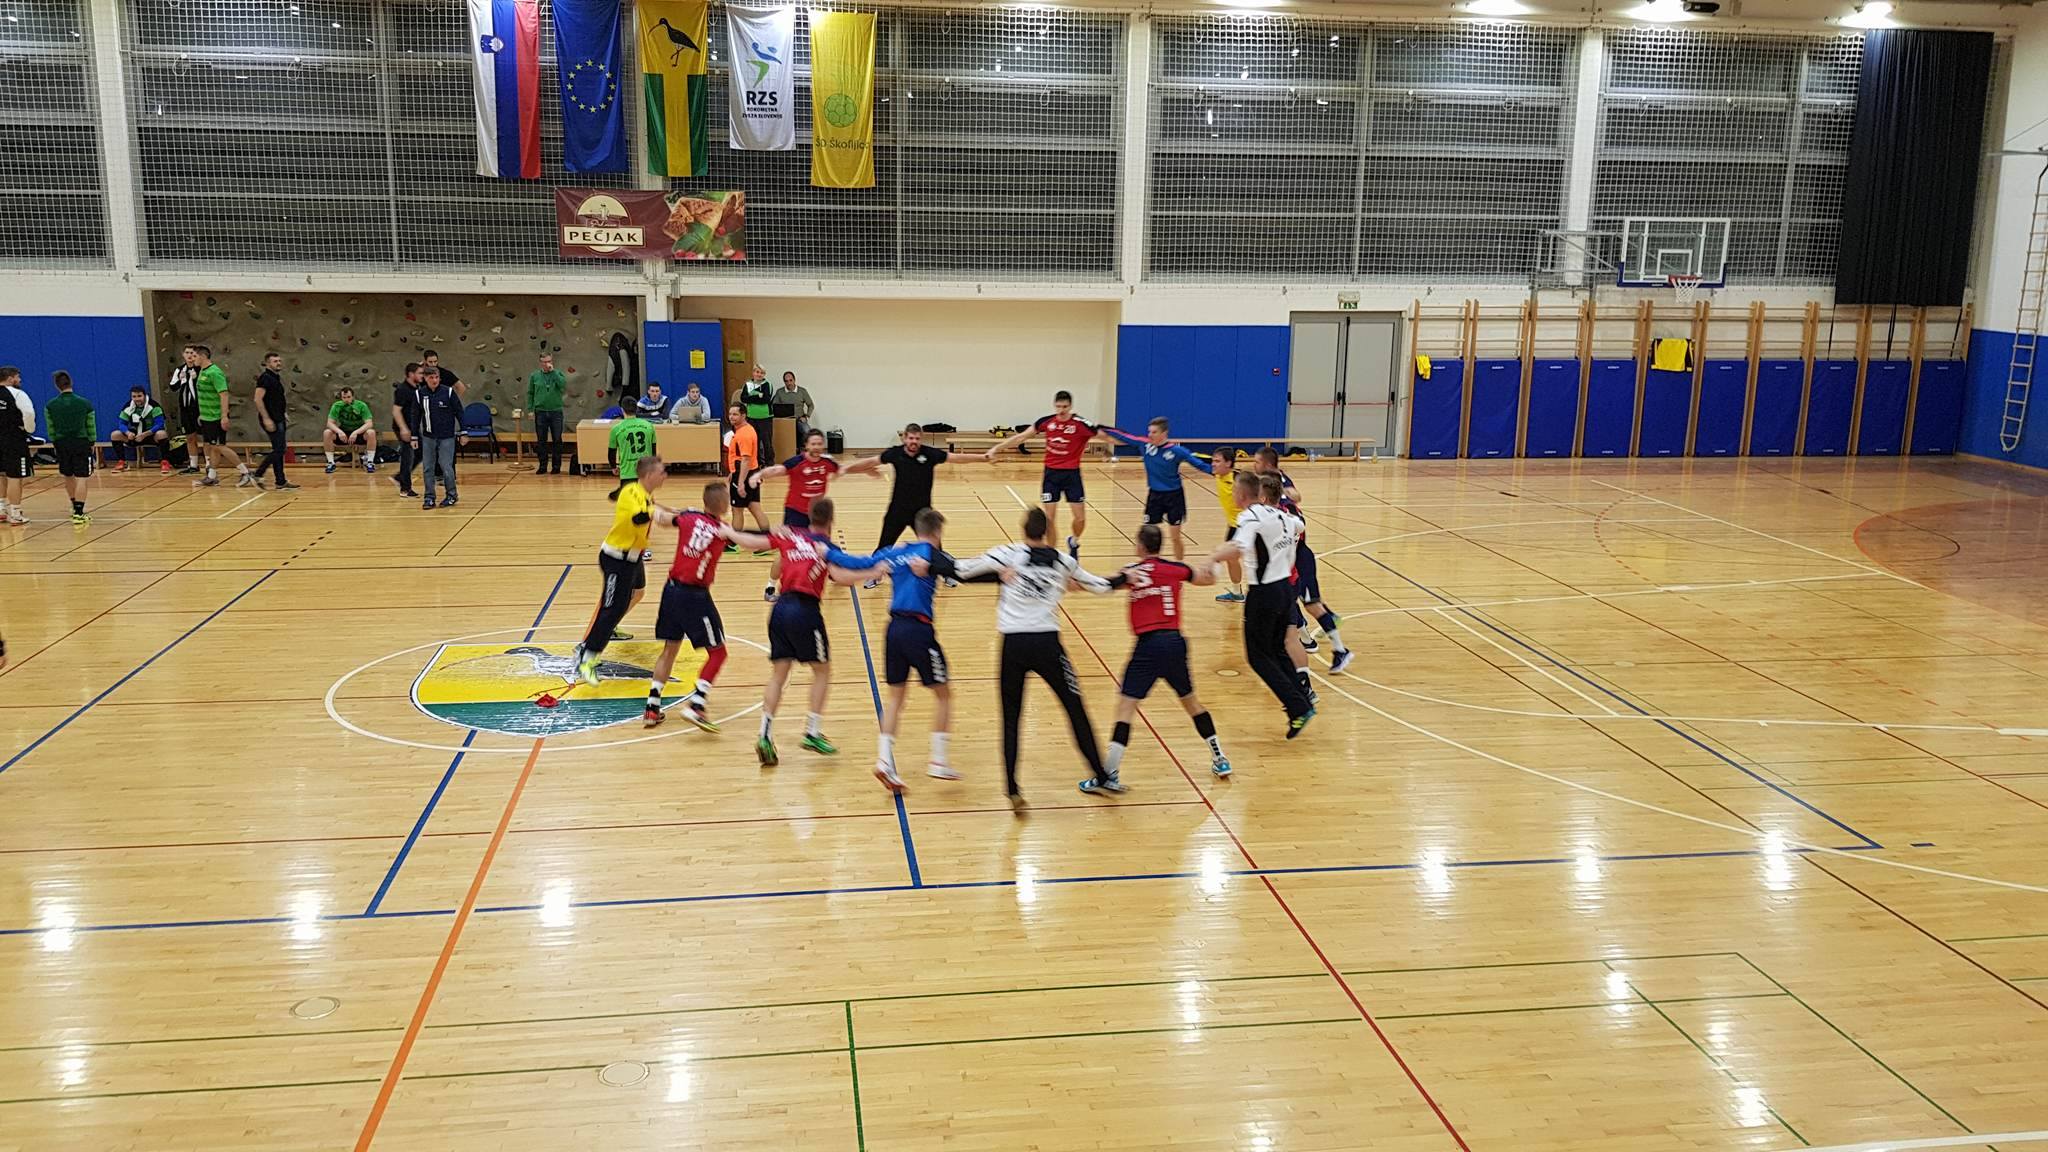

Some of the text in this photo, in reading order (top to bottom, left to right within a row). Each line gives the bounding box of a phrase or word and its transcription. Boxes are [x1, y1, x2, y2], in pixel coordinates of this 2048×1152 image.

[746, 90, 778, 106] RZS
[569, 229, 638, 243] PEČJAK
[626, 431, 646, 454] 13
